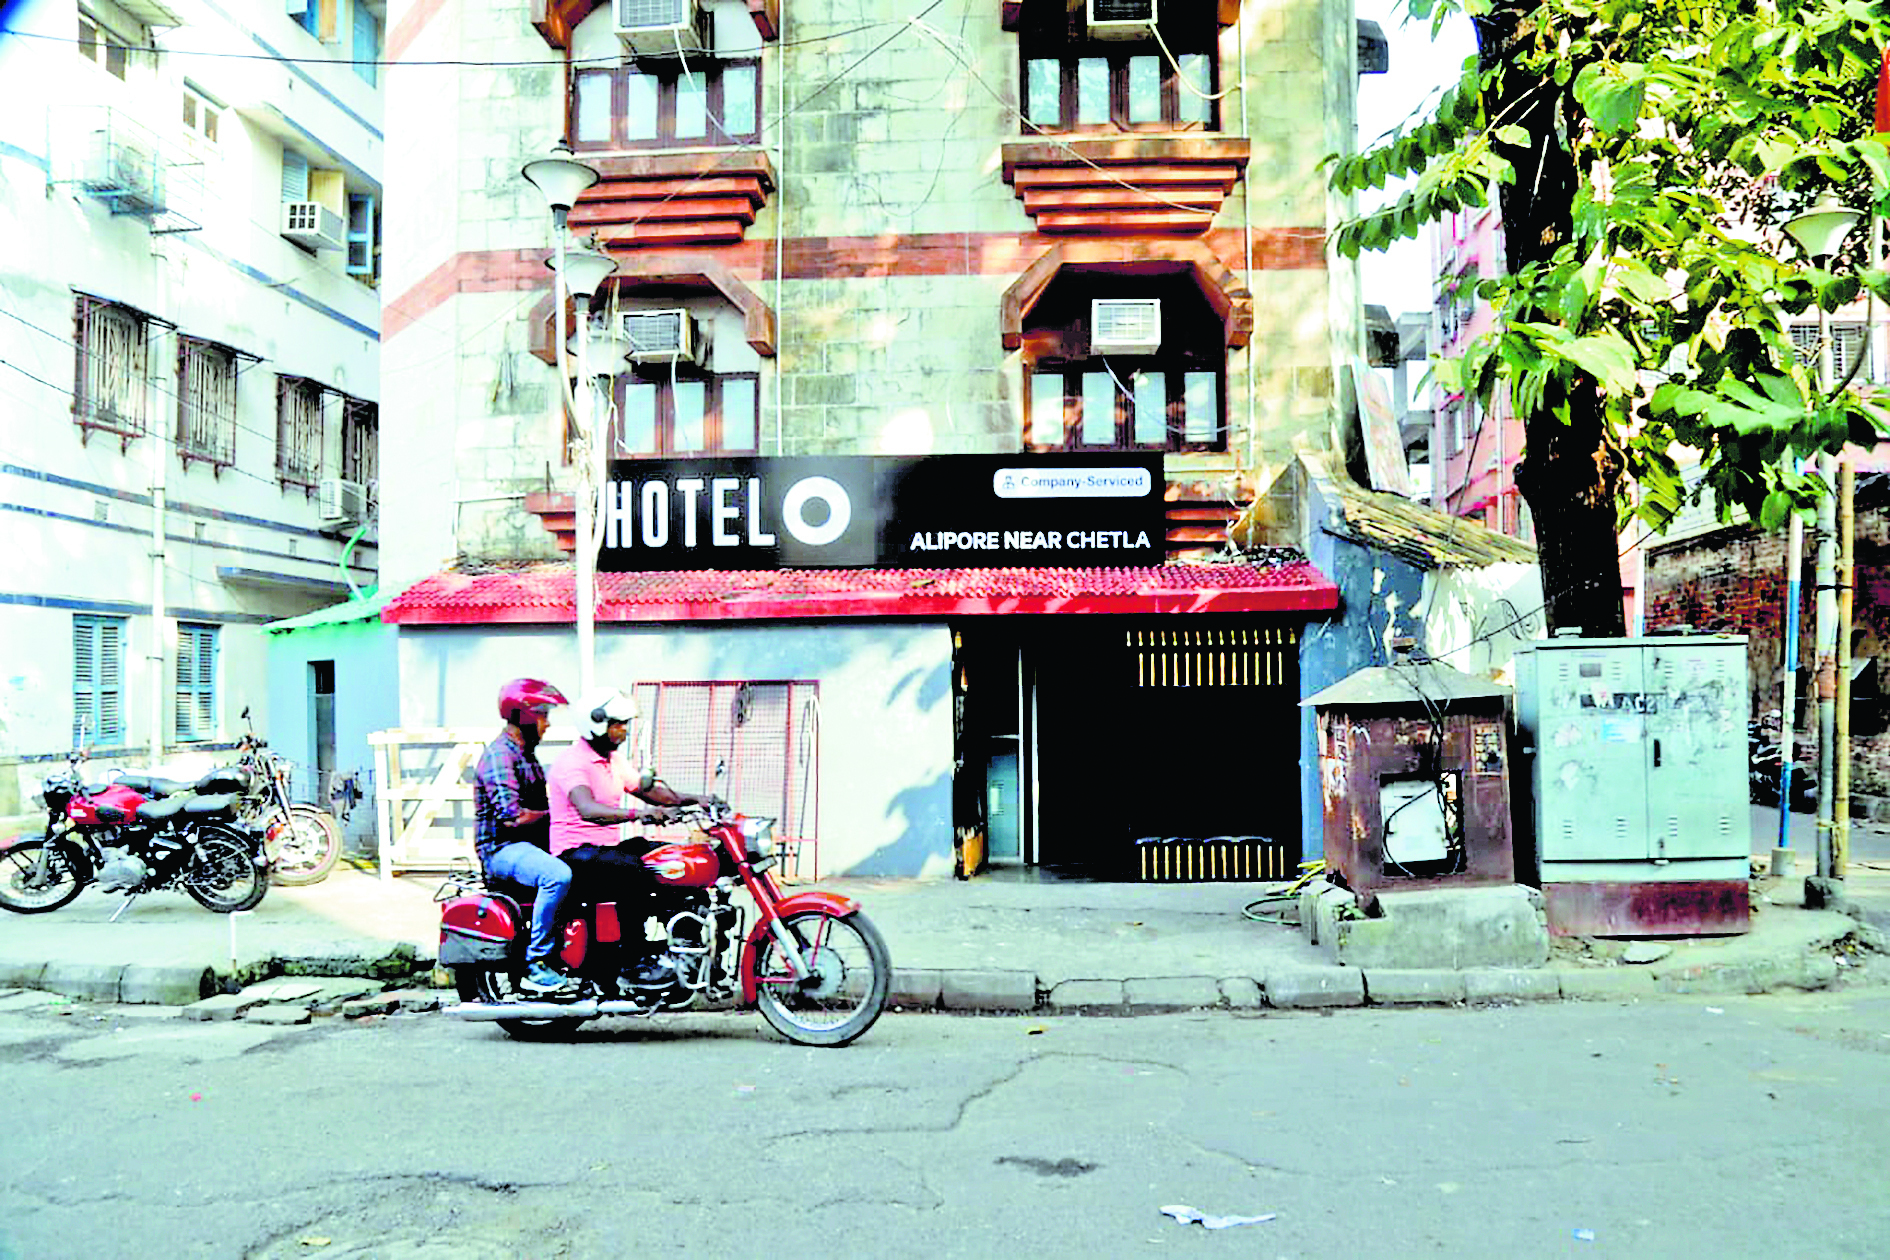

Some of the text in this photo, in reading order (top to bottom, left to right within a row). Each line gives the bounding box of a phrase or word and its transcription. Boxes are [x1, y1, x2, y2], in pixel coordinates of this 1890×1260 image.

[1021, 475, 1144, 488] Company-Serviced
[606, 477, 776, 548] HOTEL
[910, 530, 1151, 550] ALIPORE NEAR CHETLA
